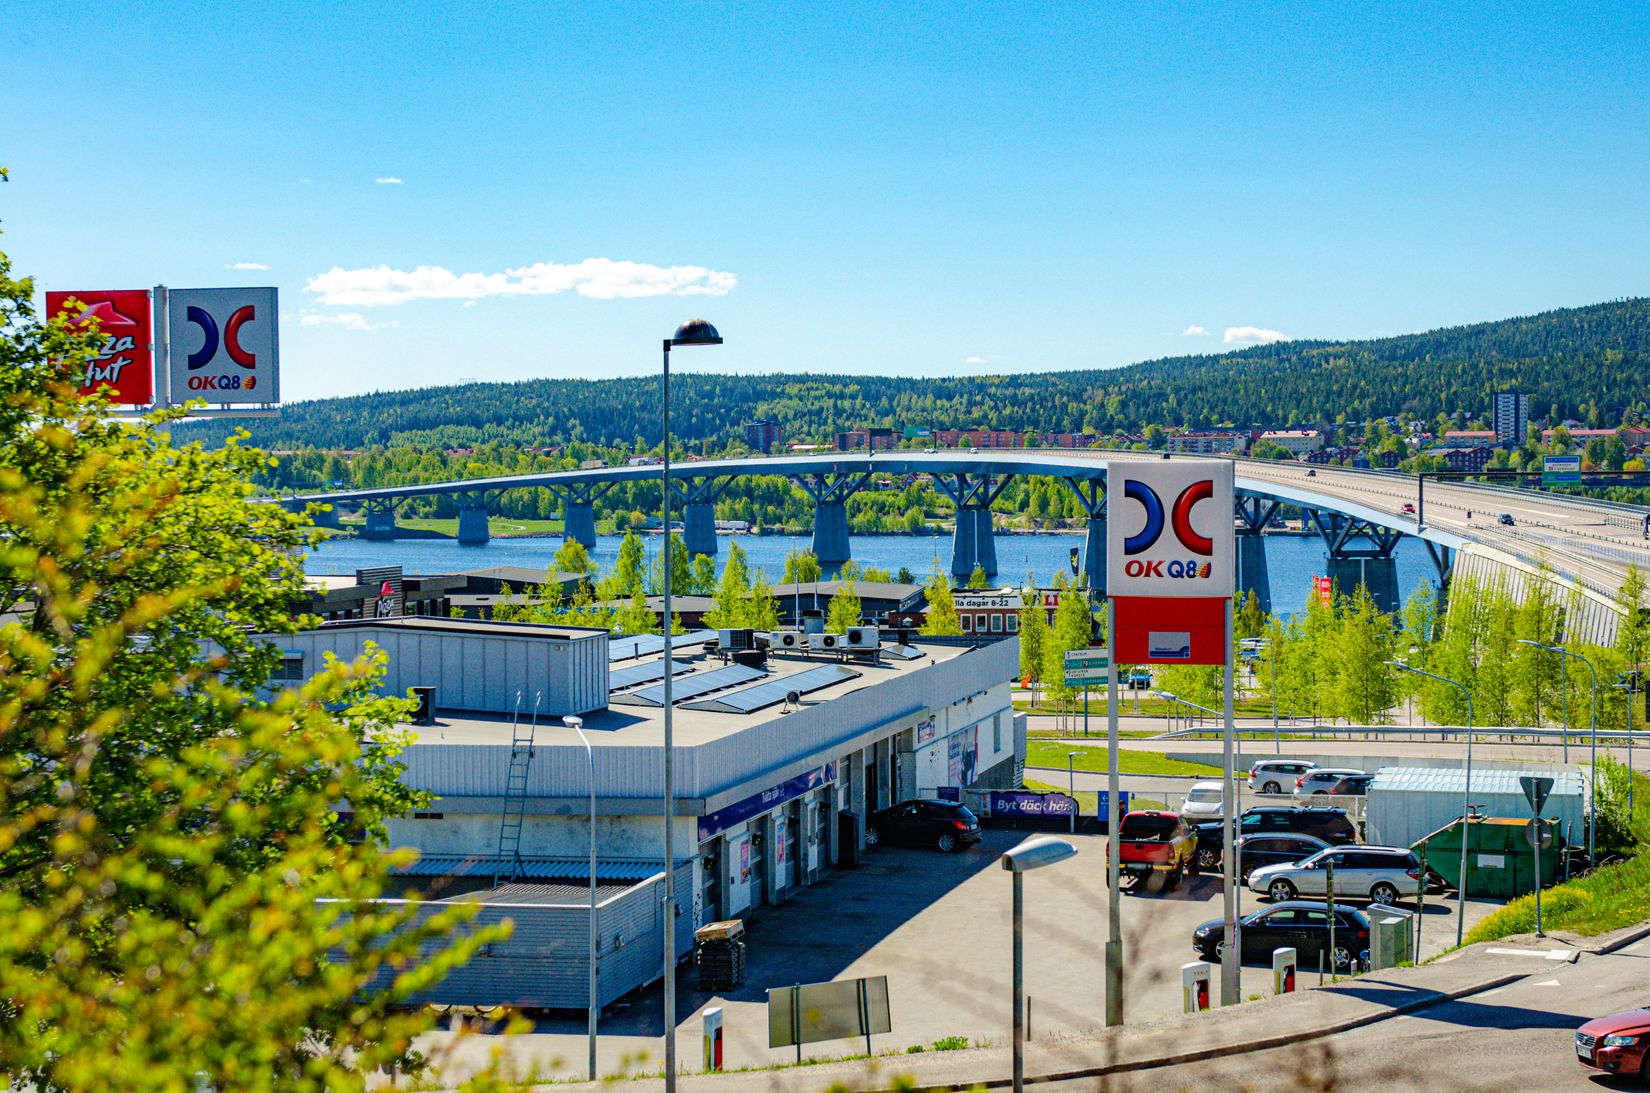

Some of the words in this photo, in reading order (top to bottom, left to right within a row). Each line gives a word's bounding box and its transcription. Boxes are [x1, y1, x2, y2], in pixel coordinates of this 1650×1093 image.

[966, 600, 989, 608] dagar
[997, 800, 1018, 812] Byt
[1019, 800, 1047, 811] däck
